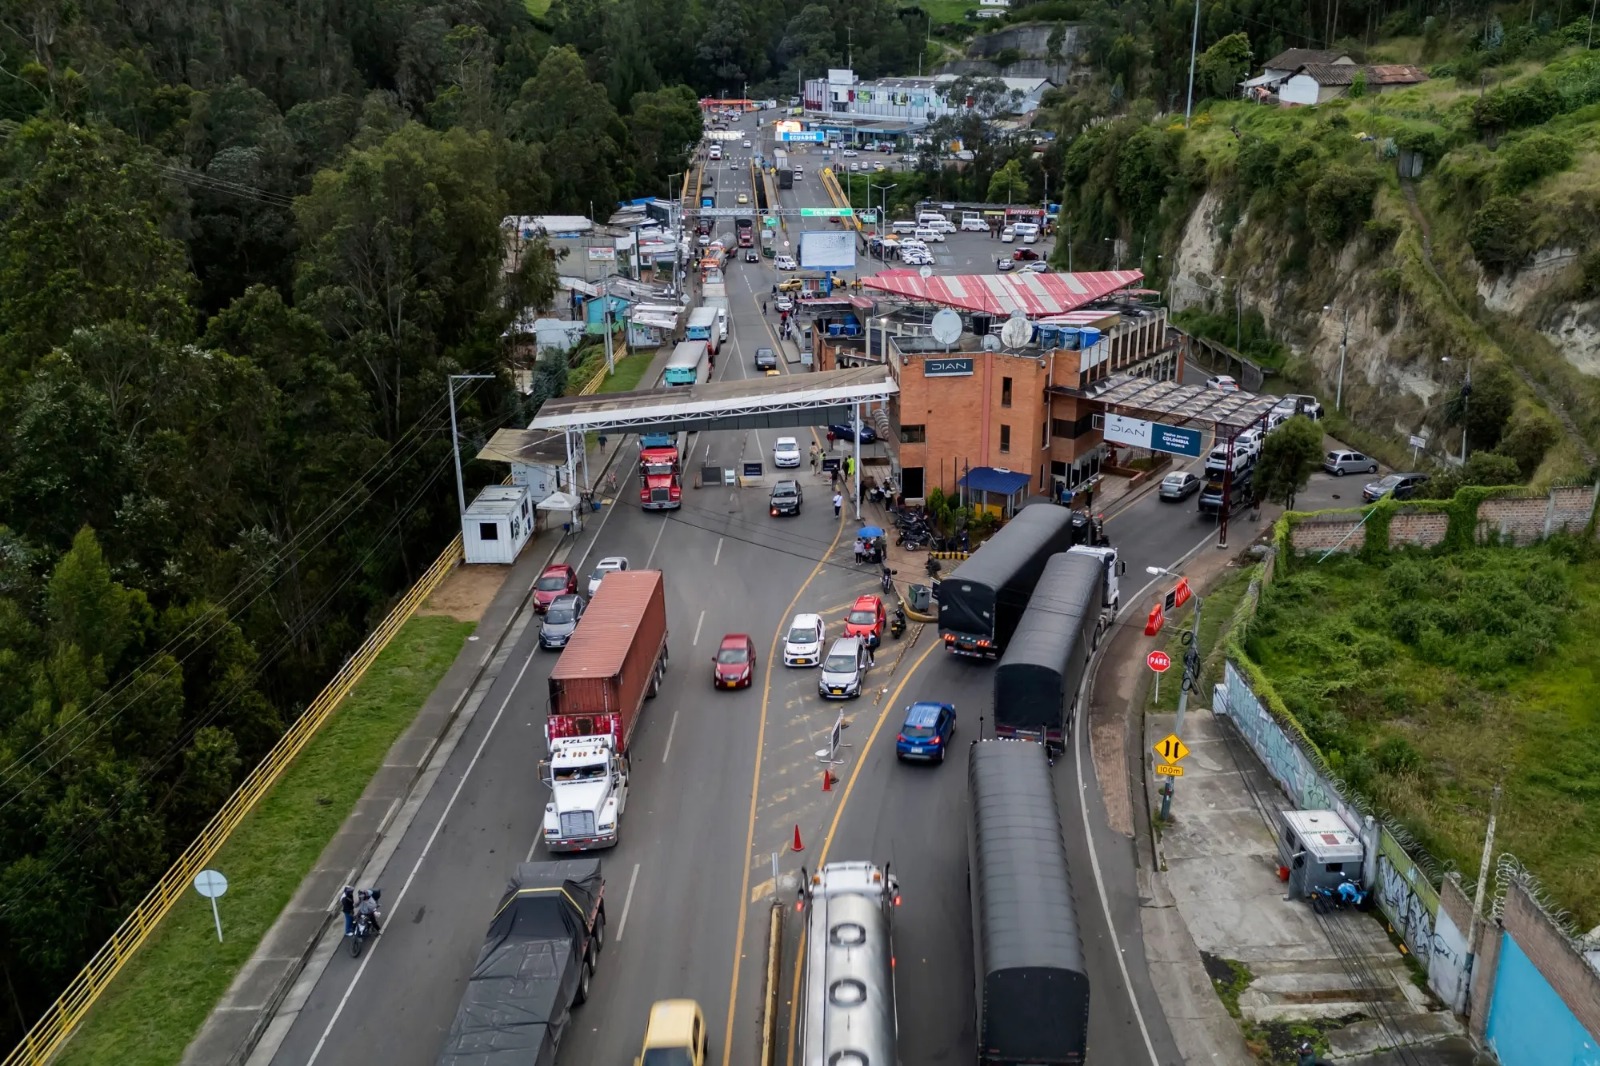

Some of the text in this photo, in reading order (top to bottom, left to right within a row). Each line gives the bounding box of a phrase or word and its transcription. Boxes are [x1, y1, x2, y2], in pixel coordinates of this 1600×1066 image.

[931, 362, 967, 371] DIAN
[1110, 424, 1145, 438] DIAN
[1162, 435, 1190, 446] COLOMBIA
[1150, 656, 1167, 666] PARE
[562, 737, 605, 745] PZL-470
[1160, 766, 1180, 775] 100m
